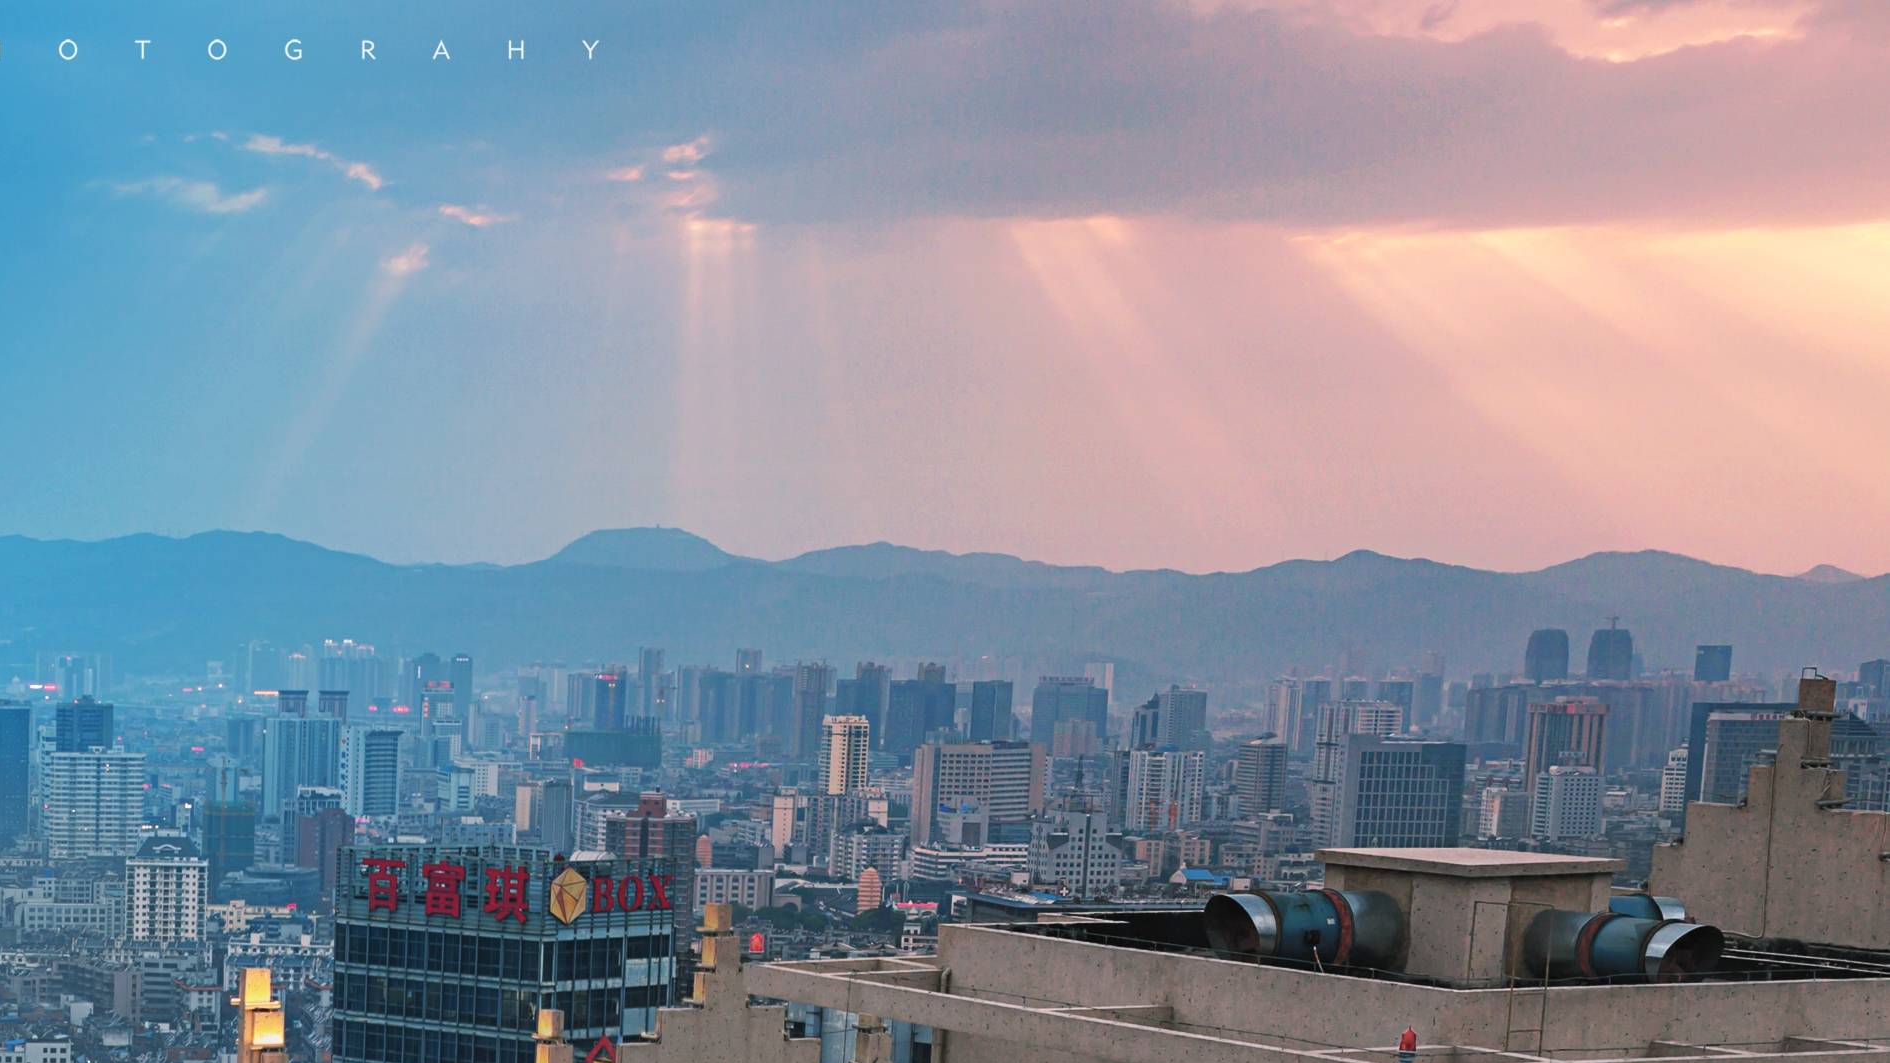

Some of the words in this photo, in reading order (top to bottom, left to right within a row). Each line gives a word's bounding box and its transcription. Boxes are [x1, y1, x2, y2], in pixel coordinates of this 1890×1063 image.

[361, 857, 531, 925] 百富琪
[591, 873, 674, 914] BOX
